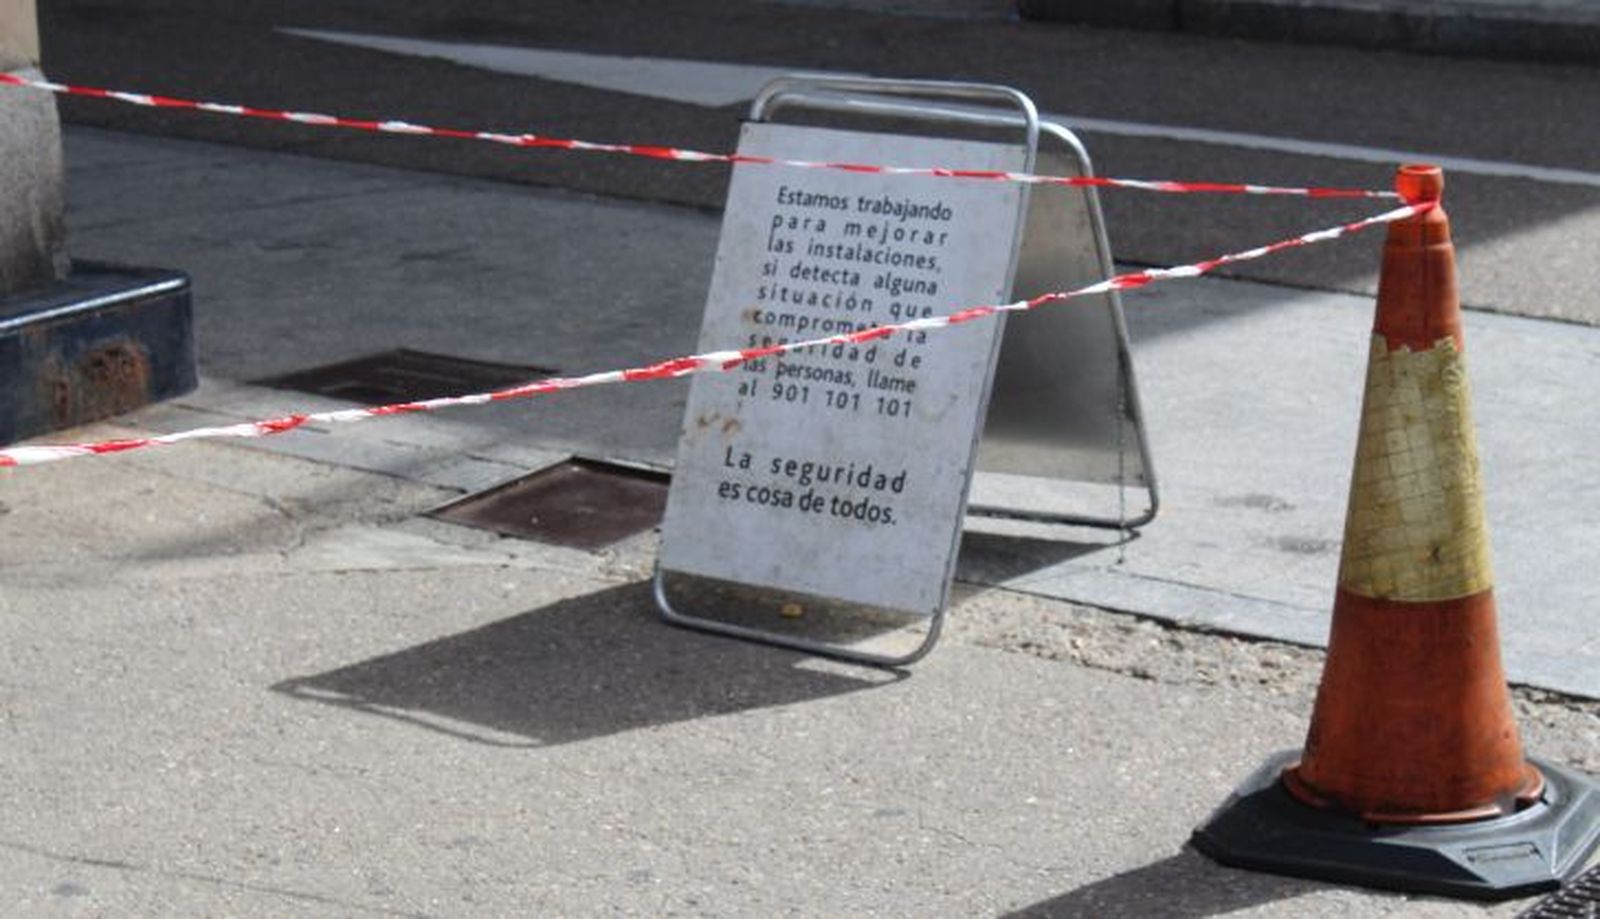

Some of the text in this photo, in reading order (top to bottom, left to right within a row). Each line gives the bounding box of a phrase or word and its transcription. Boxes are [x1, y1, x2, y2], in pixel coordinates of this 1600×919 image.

[777, 186, 953, 221] Estamos trabajando
[767, 232, 794, 254] las
[771, 214, 949, 245] para mejorar
[762, 259, 938, 296] si detecta alguna
[757, 283, 933, 321] situación que
[752, 308, 891, 340] comprome
[893, 348, 923, 369] de
[775, 361, 856, 387] personas,
[866, 369, 917, 394] llame
[738, 379, 912, 417] al 901 101 101
[724, 445, 907, 493] La seguridad
[718, 480, 897, 525] es cosa de todos.
